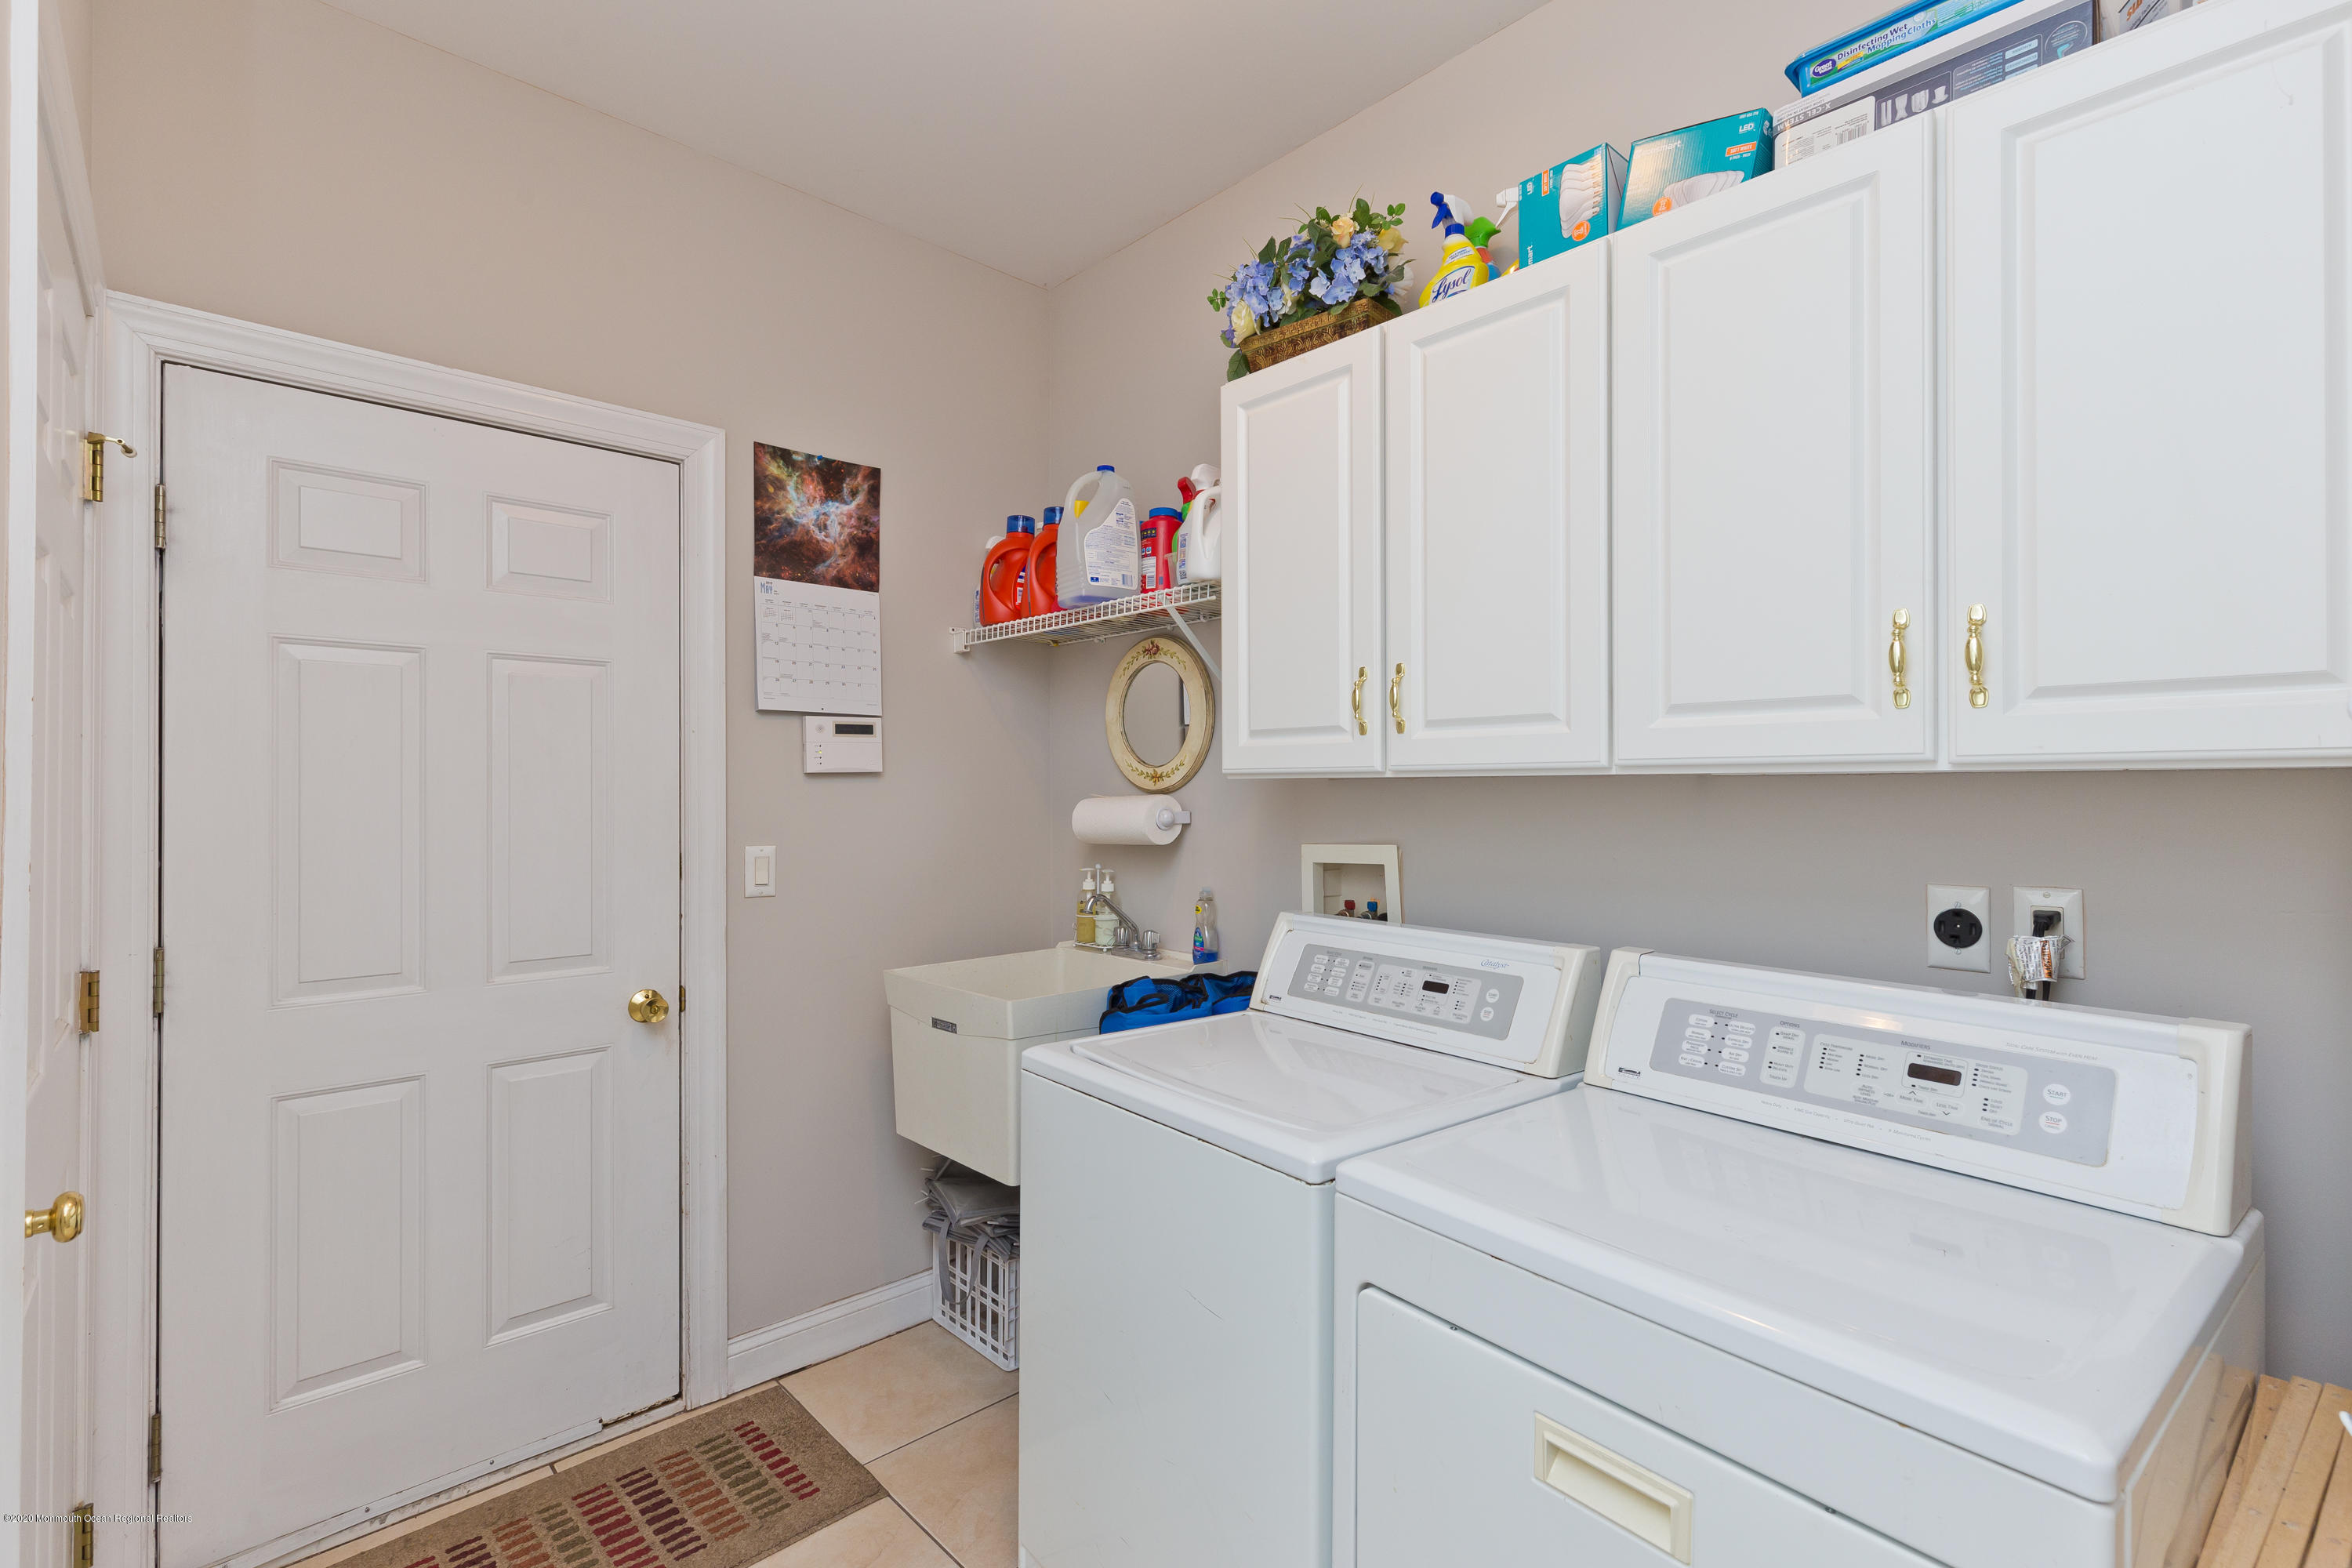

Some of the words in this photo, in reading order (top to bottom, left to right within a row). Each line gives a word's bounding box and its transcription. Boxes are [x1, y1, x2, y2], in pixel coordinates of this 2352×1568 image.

[1867, 32, 1907, 53] Mopping
[1907, 18, 1936, 35] Cloths
[1837, 34, 1888, 60] Disinfecting
[1889, 24, 1907, 36] Wet
[1814, 60, 1832, 72] Great
[1808, 102, 1831, 116] X-CEL
[1739, 123, 1755, 132] LED
[1777, 115, 1804, 131] STEAM
[1432, 268, 1472, 303] Lysol
[1480, 960, 1510, 970] Catalyst
[1900, 1040, 1931, 1050] MODIFIERS
[2046, 1089, 2067, 1098] START
[2045, 1115, 2063, 1123] STOP
